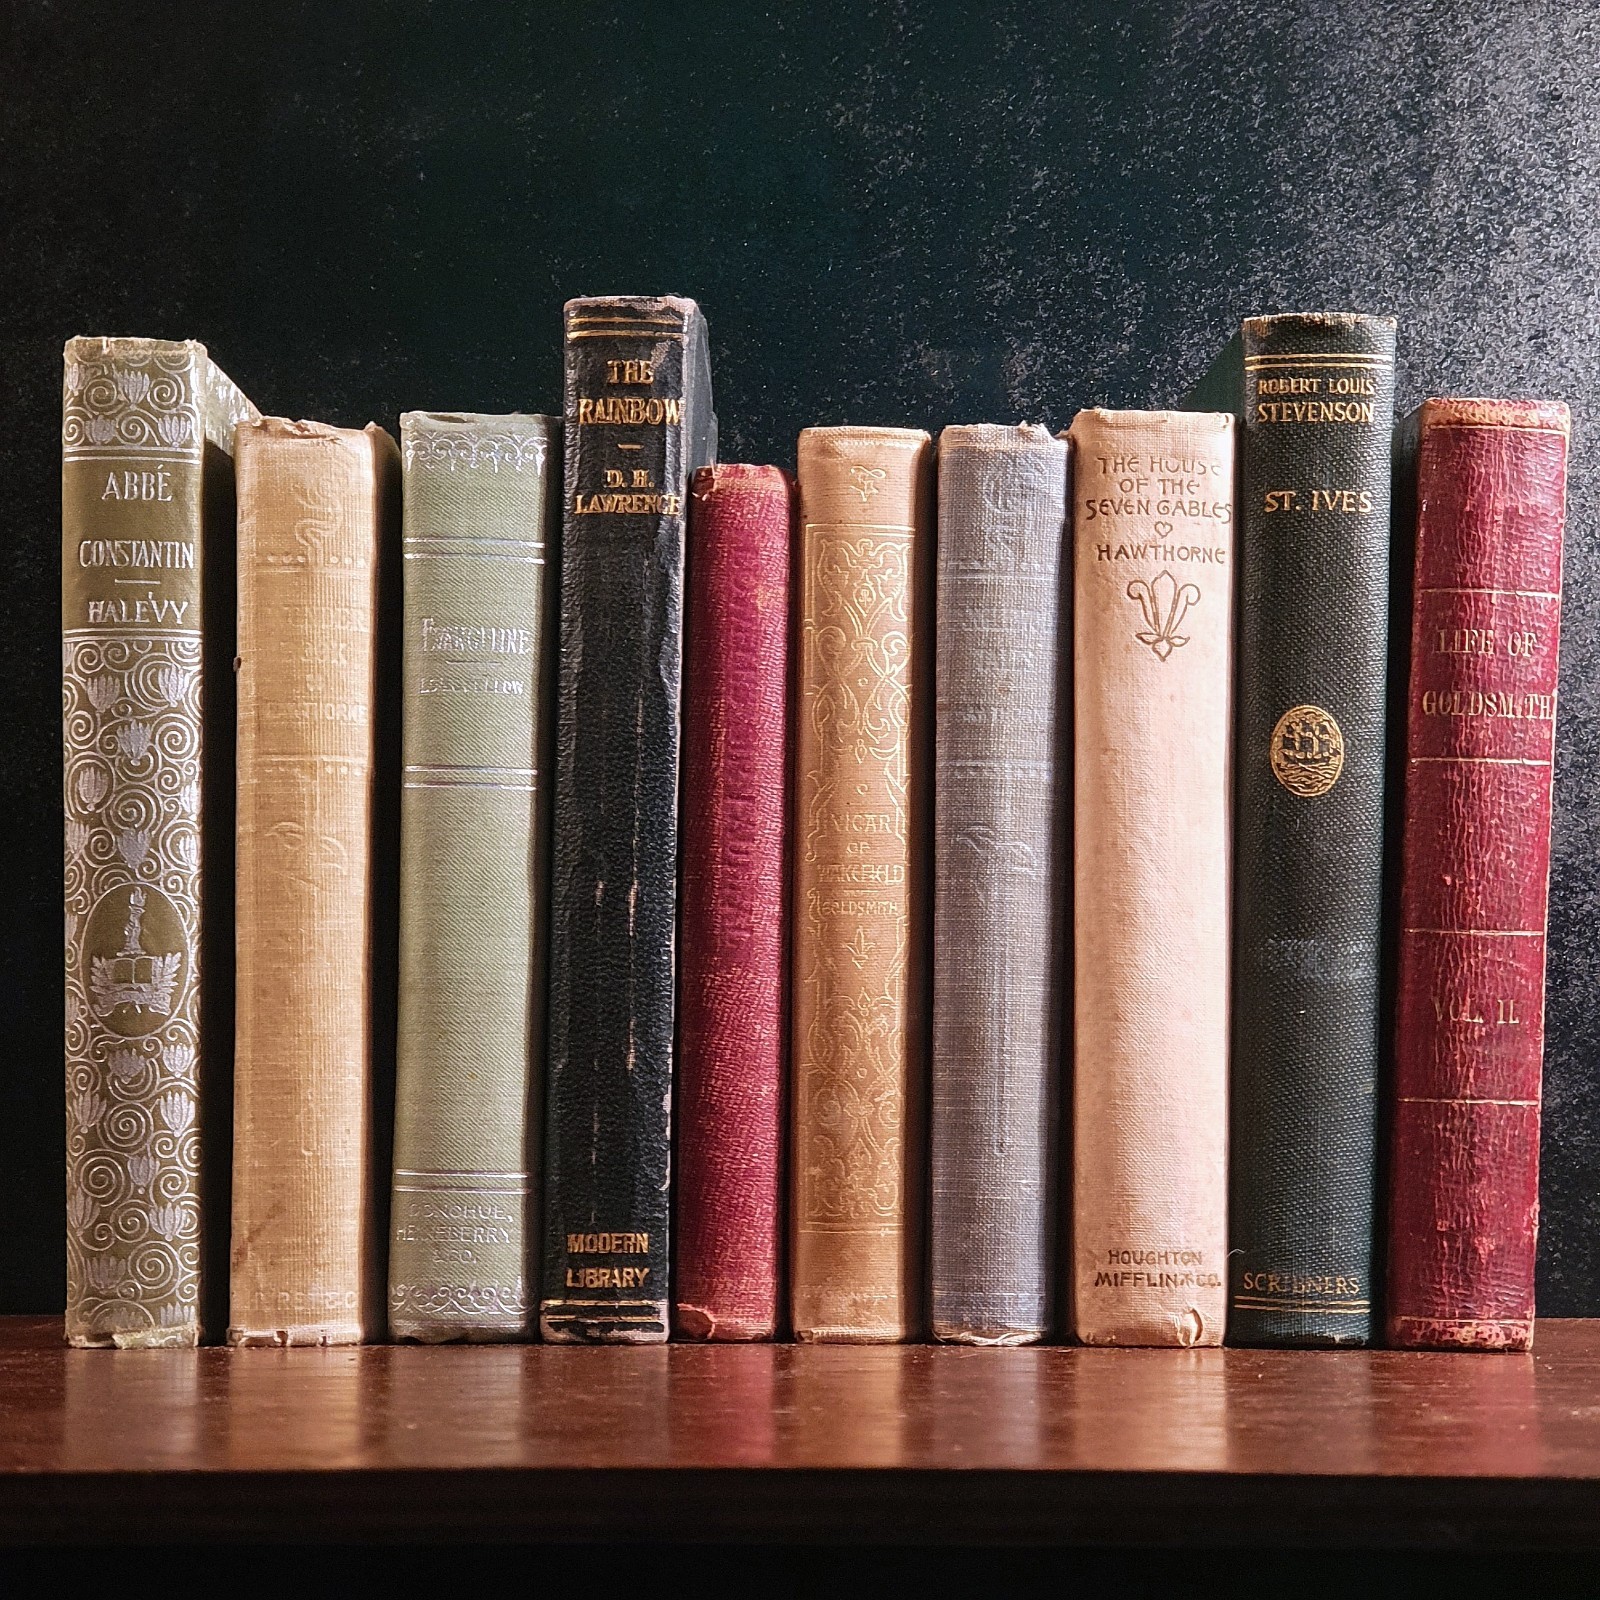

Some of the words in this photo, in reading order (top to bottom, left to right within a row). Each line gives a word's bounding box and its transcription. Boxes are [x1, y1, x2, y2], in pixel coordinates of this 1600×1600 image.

[607, 359, 655, 384] THE
[1258, 377, 1321, 395] ROBERT
[1329, 378, 1376, 395] LOUIS
[578, 397, 681, 426] RAINBOW
[1257, 401, 1375, 423] STEVENSON
[1097, 457, 1140, 474] THE
[1150, 456, 1222, 476] HOUSE
[101, 464, 173, 501] ABBÉ
[604, 469, 627, 488] D.
[631, 469, 655, 488] H.
[1119, 478, 1149, 494] OF
[1158, 478, 1200, 495] THE
[574, 493, 681, 515] LAWRENCE
[1085, 499, 1150, 521] SEVEN
[1156, 499, 1233, 524] GABLES
[1264, 490, 1302, 513] ST.
[1311, 490, 1373, 513] IVES
[78, 539, 194, 569] CONSTANTIN
[1096, 543, 1226, 565] HAWTHORNE
[1434, 629, 1495, 654] LIFE
[1508, 632, 1537, 657] OF
[1422, 690, 1554, 719] GOLDSMITH
[829, 812, 893, 833] VICAR
[846, 841, 871, 855] OF
[566, 1232, 649, 1254] MODERN
[1108, 1249, 1202, 1265] HOUGHTON
[566, 1266, 650, 1288] LIBRARY
[1094, 1272, 1178, 1287] MIFFLIN
[1243, 1272, 1360, 1295] SCRBNERS
